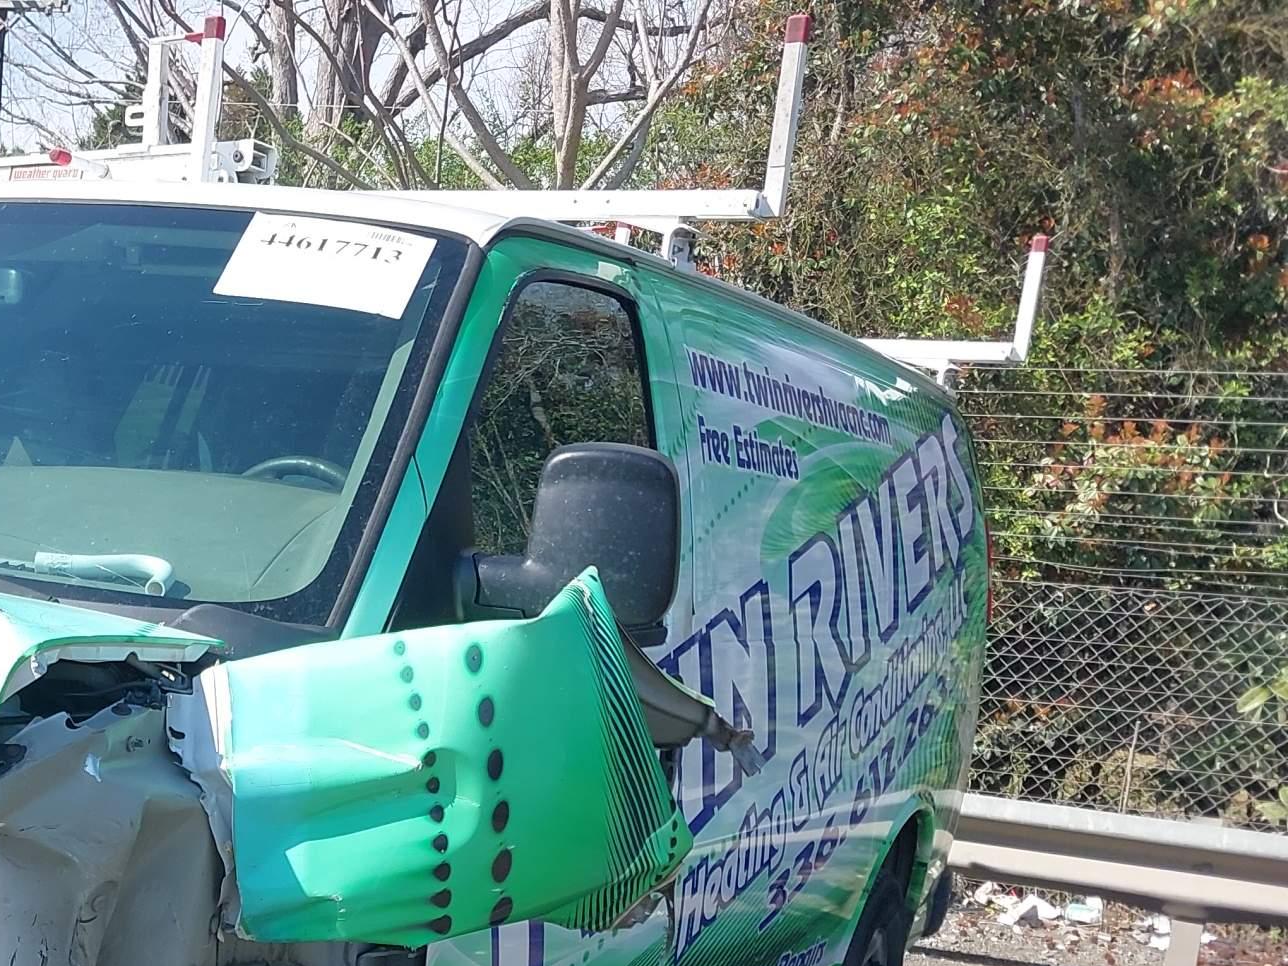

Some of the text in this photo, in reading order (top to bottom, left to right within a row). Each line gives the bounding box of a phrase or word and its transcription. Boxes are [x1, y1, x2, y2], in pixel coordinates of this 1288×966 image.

[260, 231, 404, 264] 44617713
[697, 414, 800, 480] Free Estimates
[788, 413, 976, 728] RIVERS
[675, 787, 788, 966] Heating
[789, 748, 811, 832] &
[813, 713, 847, 814] Air
